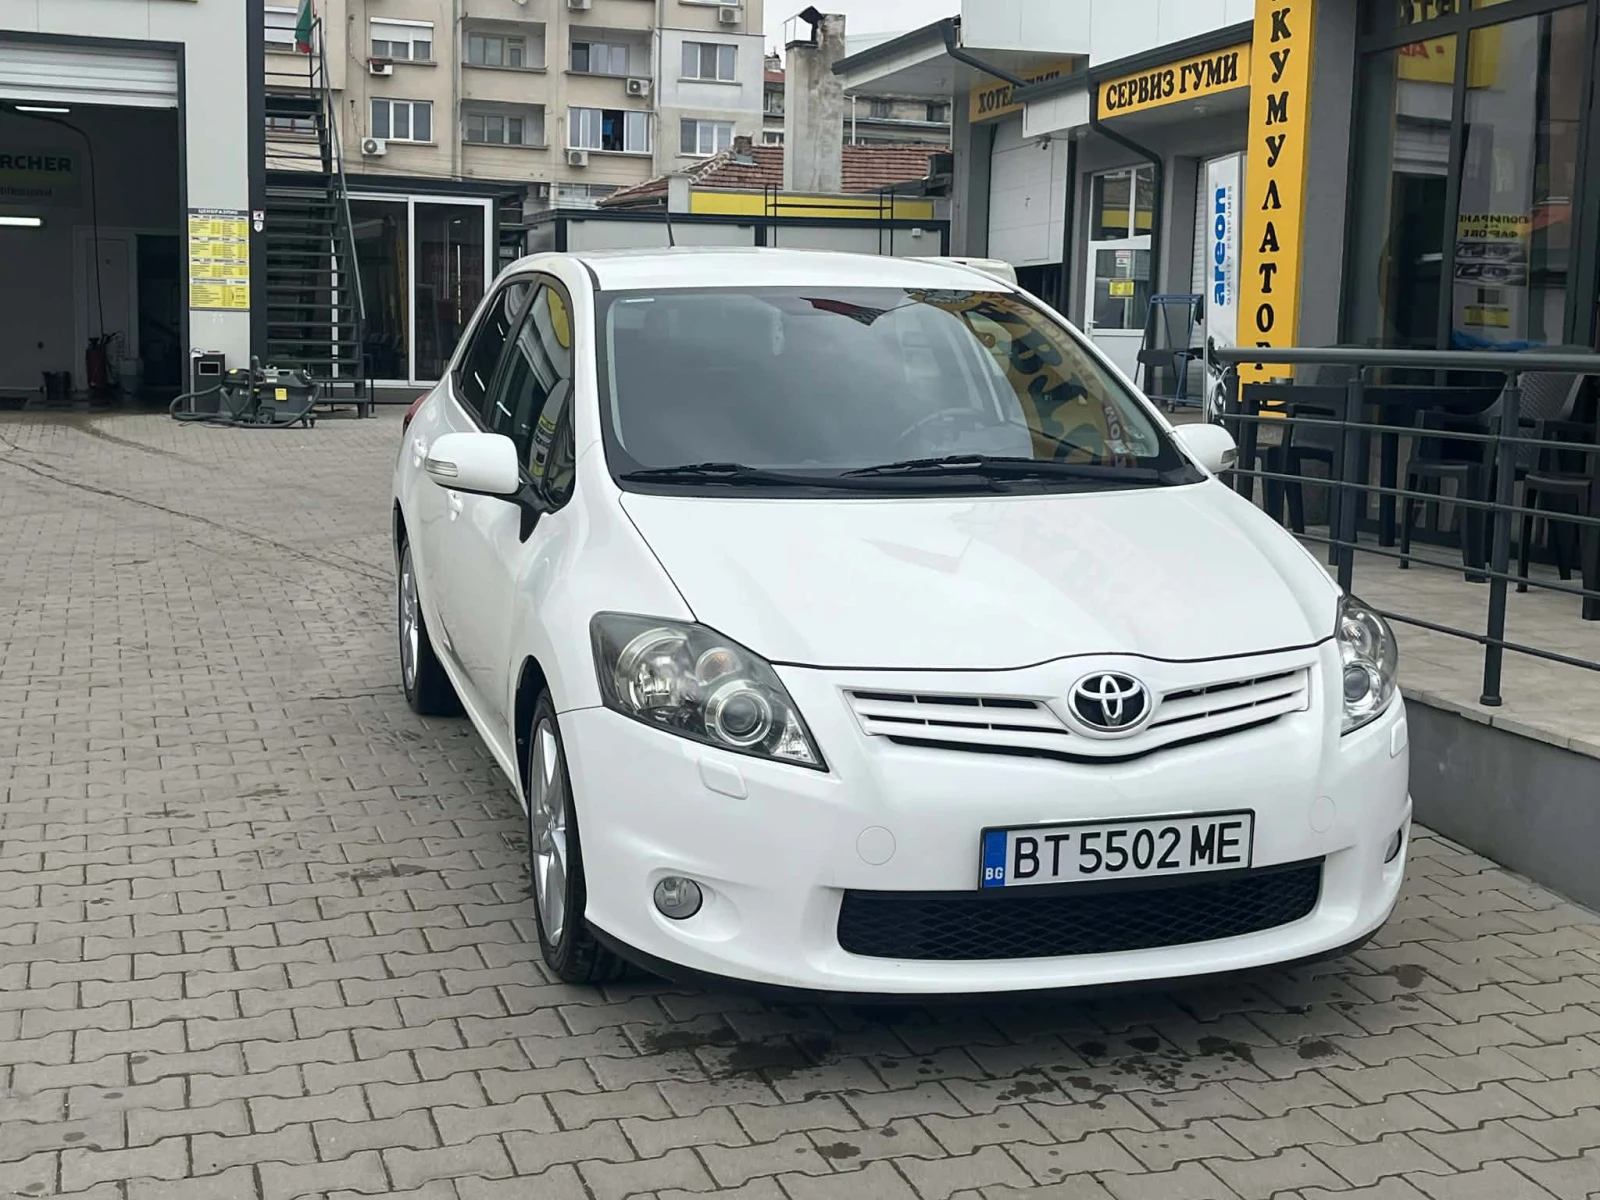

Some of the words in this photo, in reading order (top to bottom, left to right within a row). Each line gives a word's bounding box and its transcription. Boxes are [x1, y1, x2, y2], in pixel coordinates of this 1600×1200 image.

[1105, 71, 1174, 111] СЕРВИЗ
[1178, 52, 1239, 94] ГУМИ
[1214, 187, 1227, 306] areon
[985, 866, 1004, 880] BG
[1014, 834, 1069, 879] BT
[1079, 827, 1181, 873] 5502
[1190, 822, 1242, 866] ME
